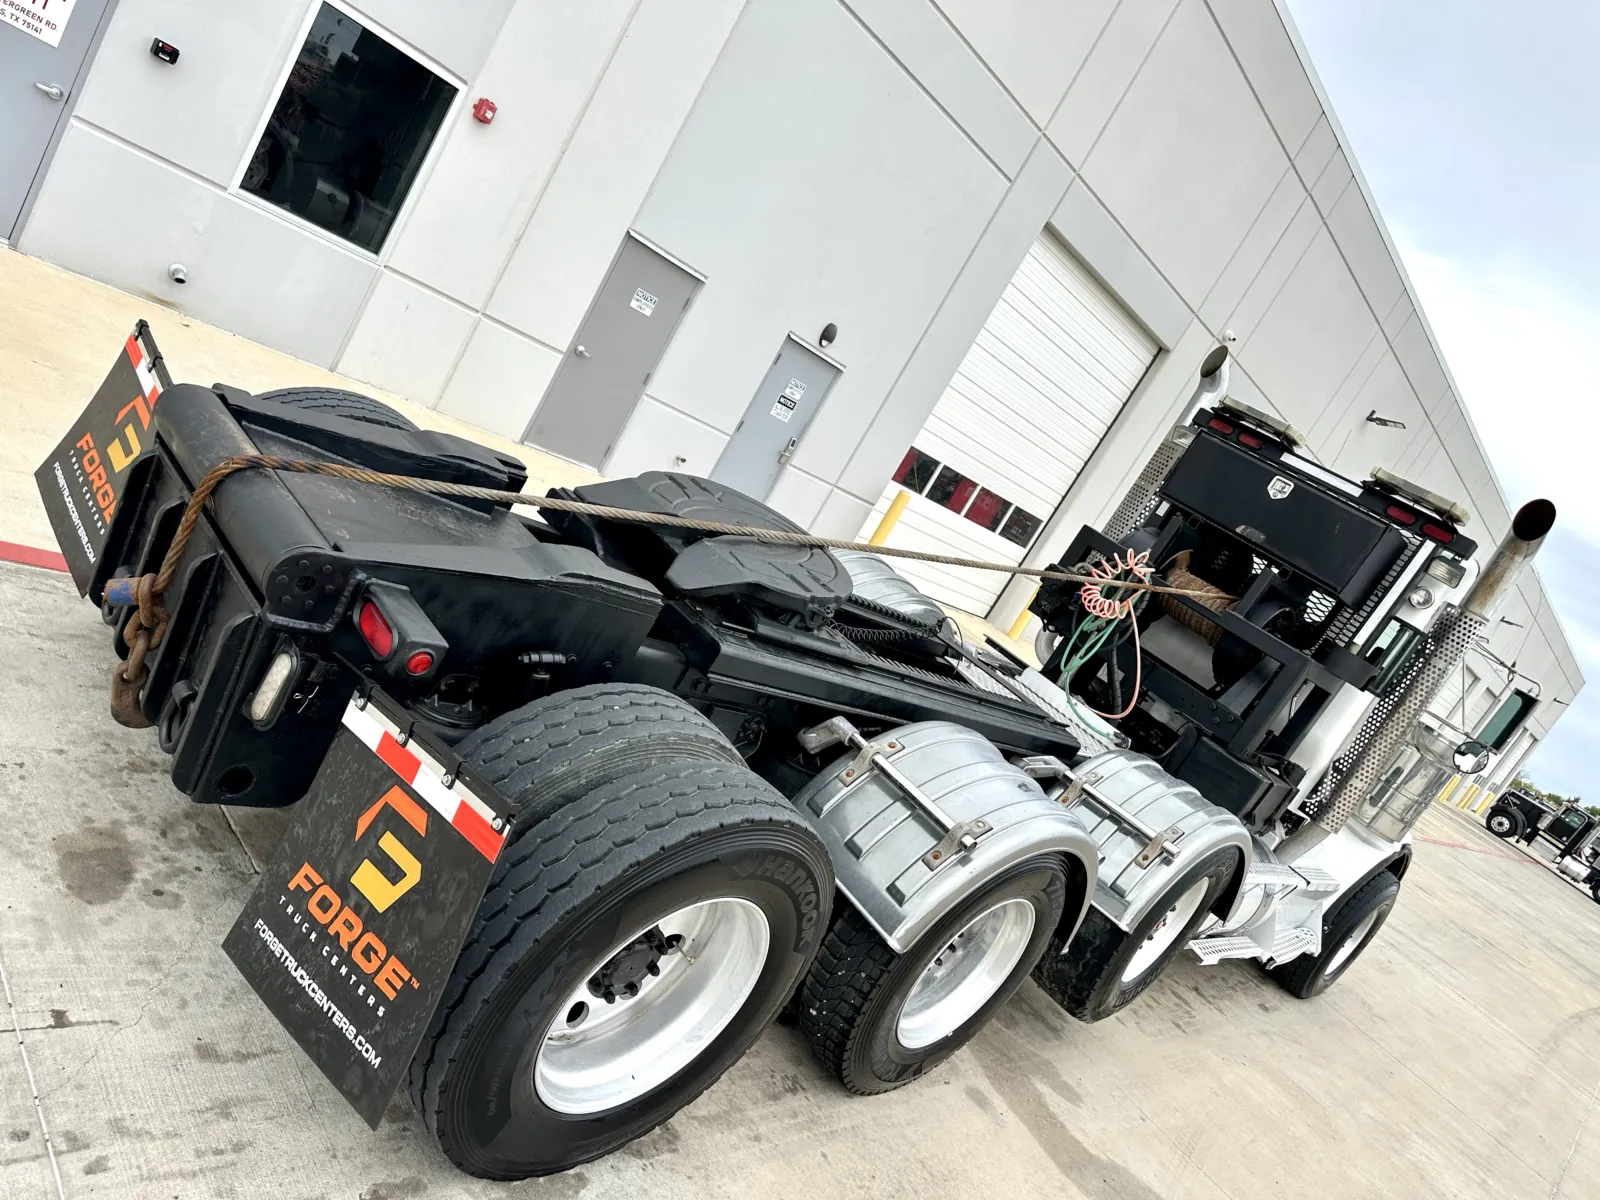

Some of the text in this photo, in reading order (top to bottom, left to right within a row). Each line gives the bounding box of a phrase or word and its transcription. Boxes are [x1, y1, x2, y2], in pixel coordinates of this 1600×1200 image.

[1, 0, 44, 23] ERGREEN
[10, 12, 21, 23] TX
[22, 19, 43, 35] 75141
[779, 396, 796, 410] NOTICE
[53, 461, 96, 564] FORGETRUCKCENTERS.COM
[69, 449, 106, 535] TRUCK CENTERS
[279, 895, 386, 1018] TRUCK CENTERS
[287, 862, 411, 1001] FORGE
[253, 918, 382, 1069] FORGETRUCKCENTERS.COM
